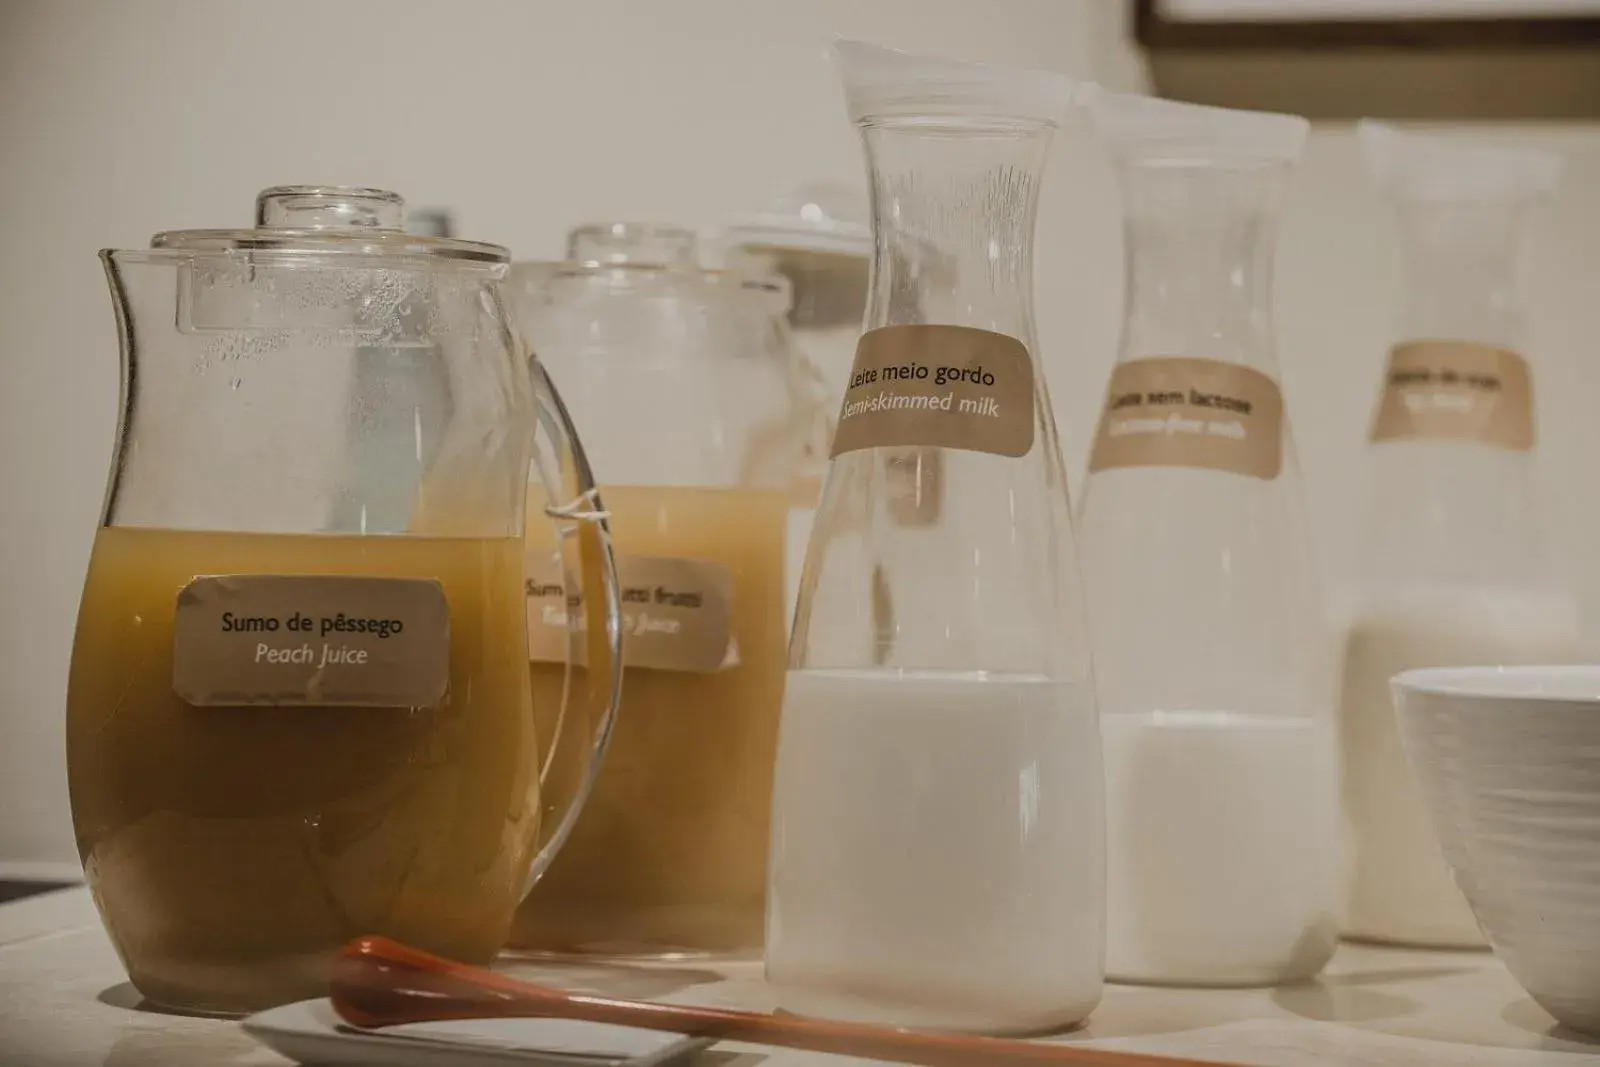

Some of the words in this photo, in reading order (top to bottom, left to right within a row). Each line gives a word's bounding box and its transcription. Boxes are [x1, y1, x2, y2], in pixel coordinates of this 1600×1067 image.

[849, 368, 877, 390] Leite
[882, 362, 928, 381] meio
[934, 366, 995, 386] gordo
[842, 392, 953, 420] Semi-skimmed
[959, 397, 1000, 418] milk
[221, 611, 279, 632] Sumo
[285, 612, 313, 632] de
[320, 612, 403, 639] pêssego
[254, 642, 313, 664] Peach
[317, 644, 368, 669] Juice
